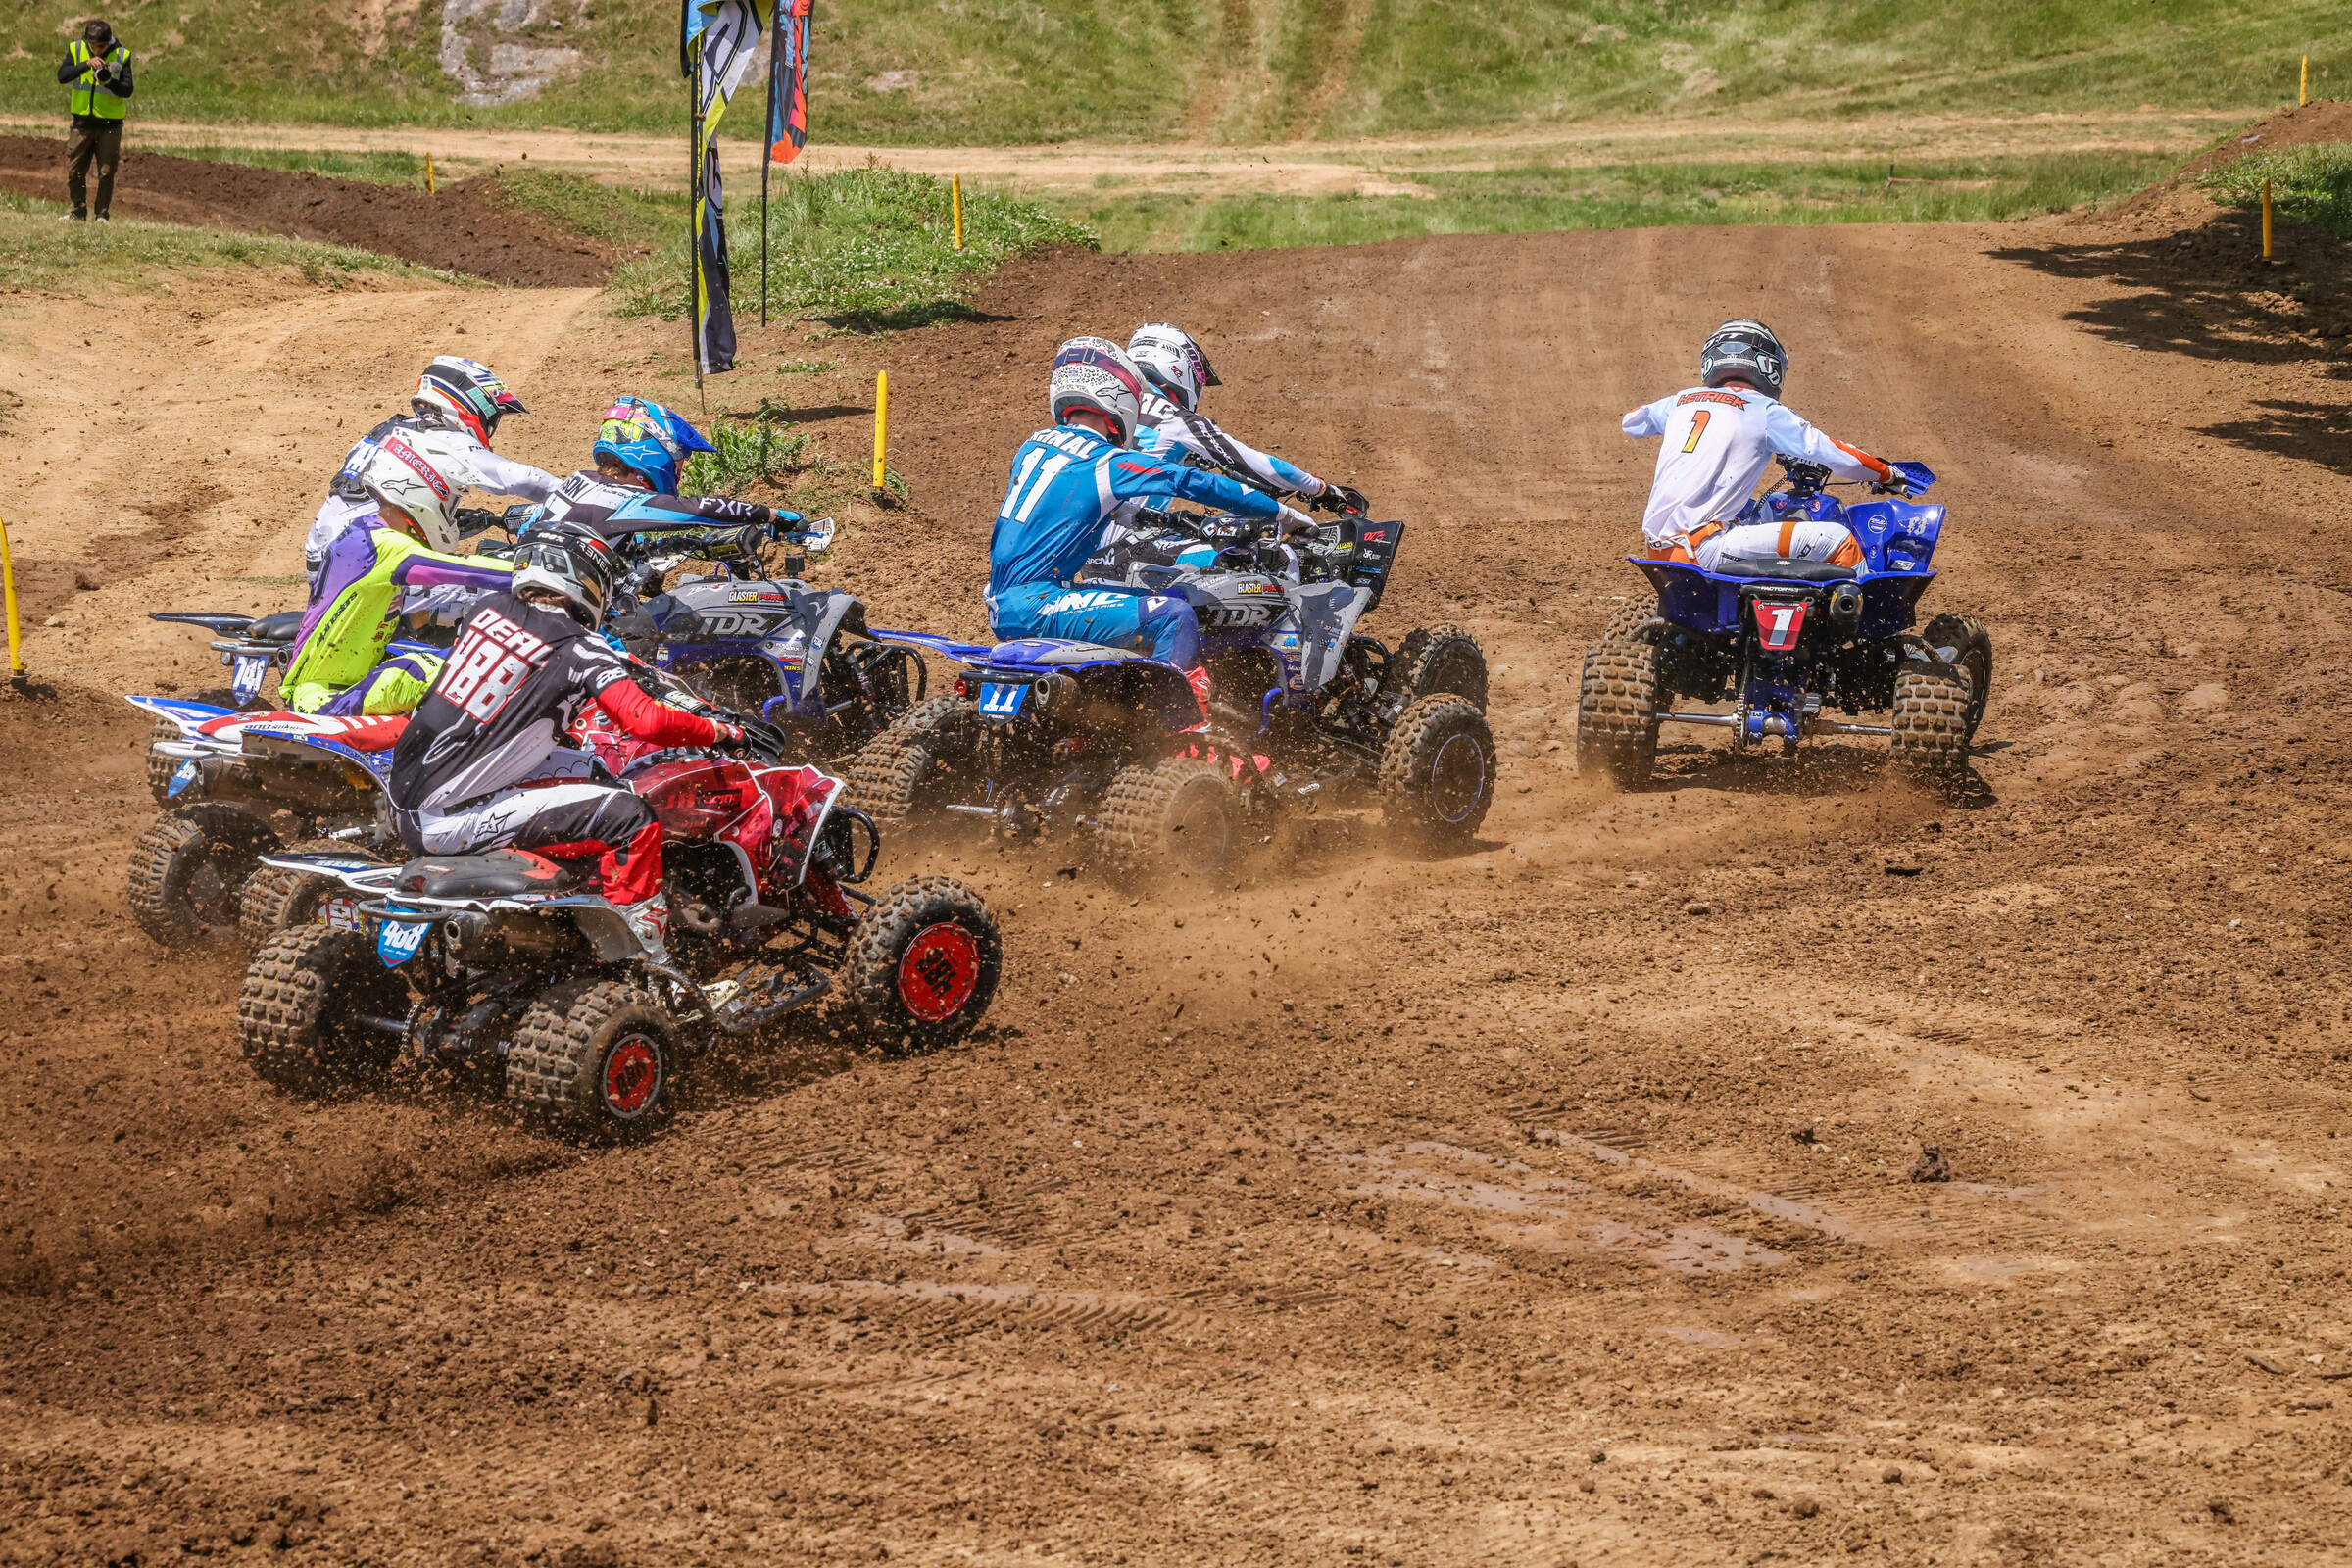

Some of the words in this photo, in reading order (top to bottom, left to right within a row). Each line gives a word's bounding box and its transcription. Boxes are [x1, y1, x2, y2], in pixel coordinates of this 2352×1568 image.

[1677, 391, 1750, 411] HETRICK
[1682, 410, 1711, 453] 1
[1000, 447, 1073, 524] 11
[699, 496, 755, 517] FXR
[537, 531, 564, 544] 100%
[1063, 603, 1125, 615] INDUSTRIES
[469, 608, 554, 668] DEAL
[1768, 609, 1794, 646] 1
[232, 656, 266, 690] 741
[435, 627, 532, 725] 488
[983, 684, 1021, 712] 11
